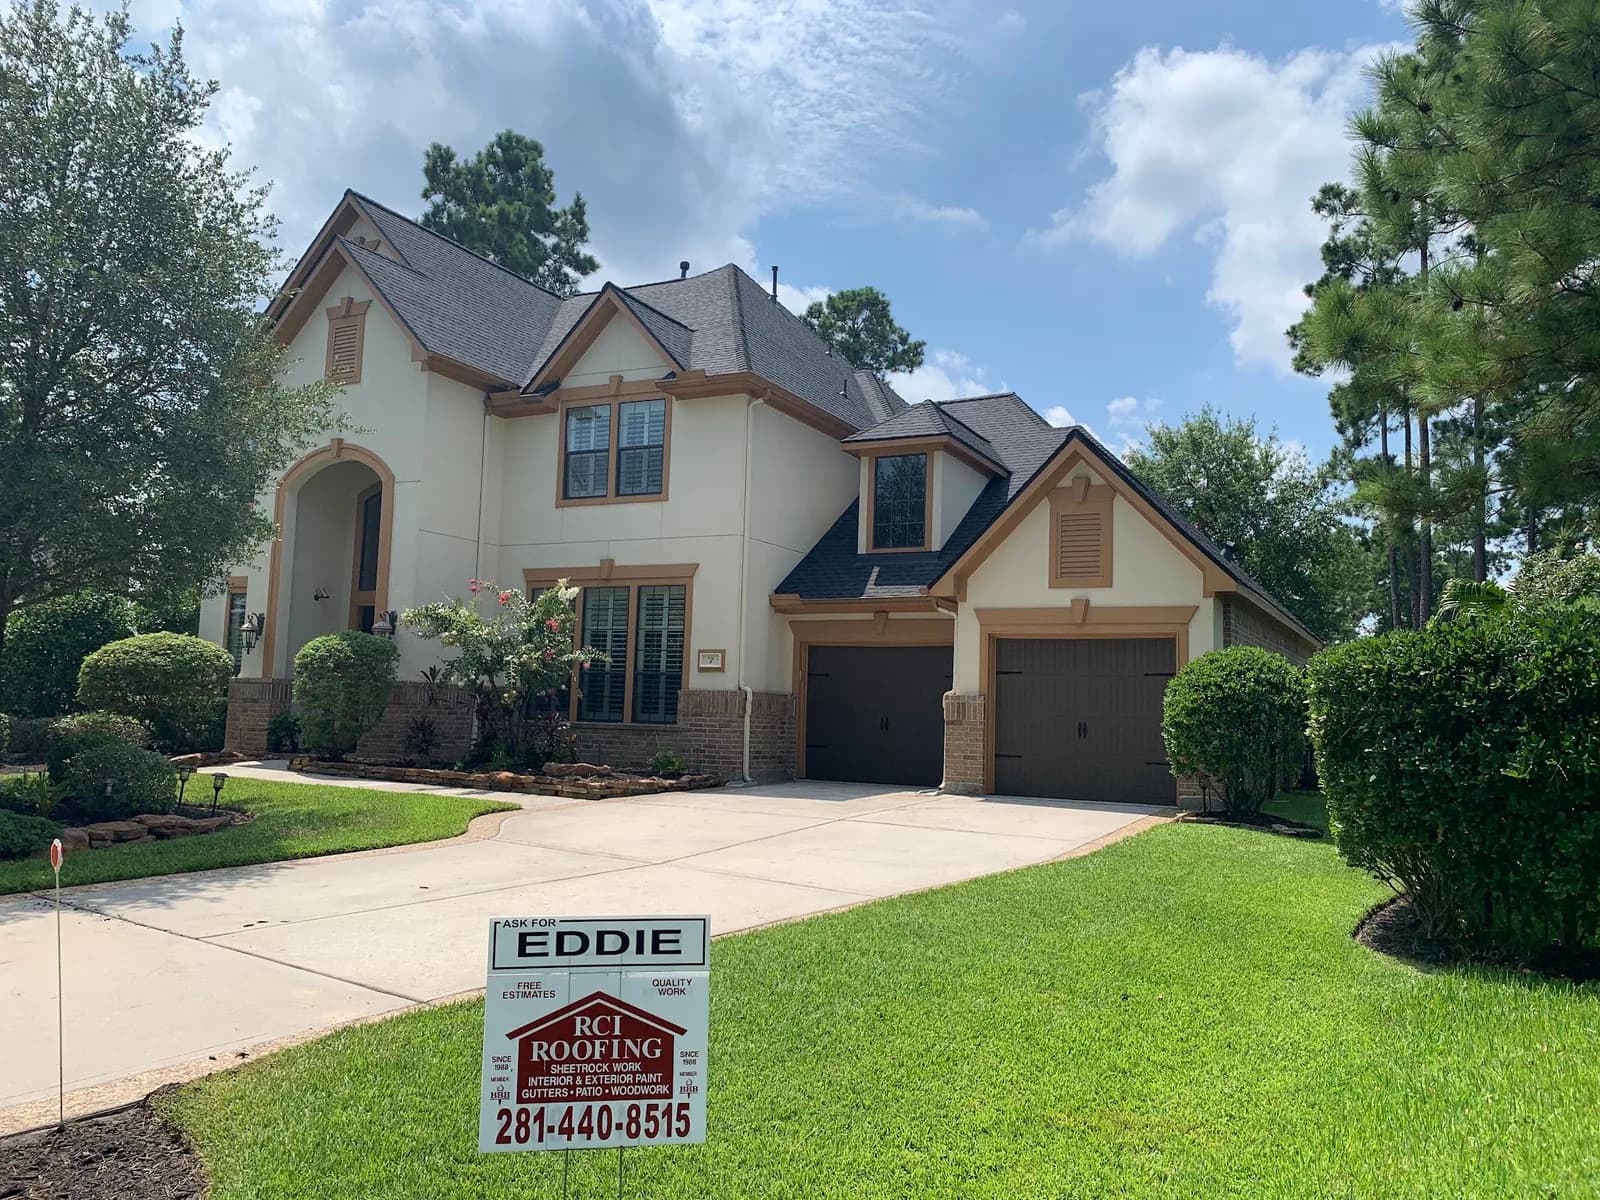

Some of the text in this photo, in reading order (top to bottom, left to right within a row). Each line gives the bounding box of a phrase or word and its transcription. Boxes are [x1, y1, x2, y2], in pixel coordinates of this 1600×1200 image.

[503, 919, 556, 928] ASK FOR
[518, 930, 682, 958] EDDIE
[518, 982, 542, 990] FREE
[652, 978, 693, 987] QUALITY
[502, 990, 556, 999] ESTIMATES
[573, 1016, 622, 1036] RCI
[530, 1038, 663, 1061] ROOFING
[551, 1062, 641, 1074] SHEETROCK WORK
[528, 1073, 663, 1086] INTERIOR & EXTERIOR PAINT
[521, 1085, 669, 1098] GUTTERS PATIO WOODWORK
[495, 1103, 690, 1144] 281-440-8515
